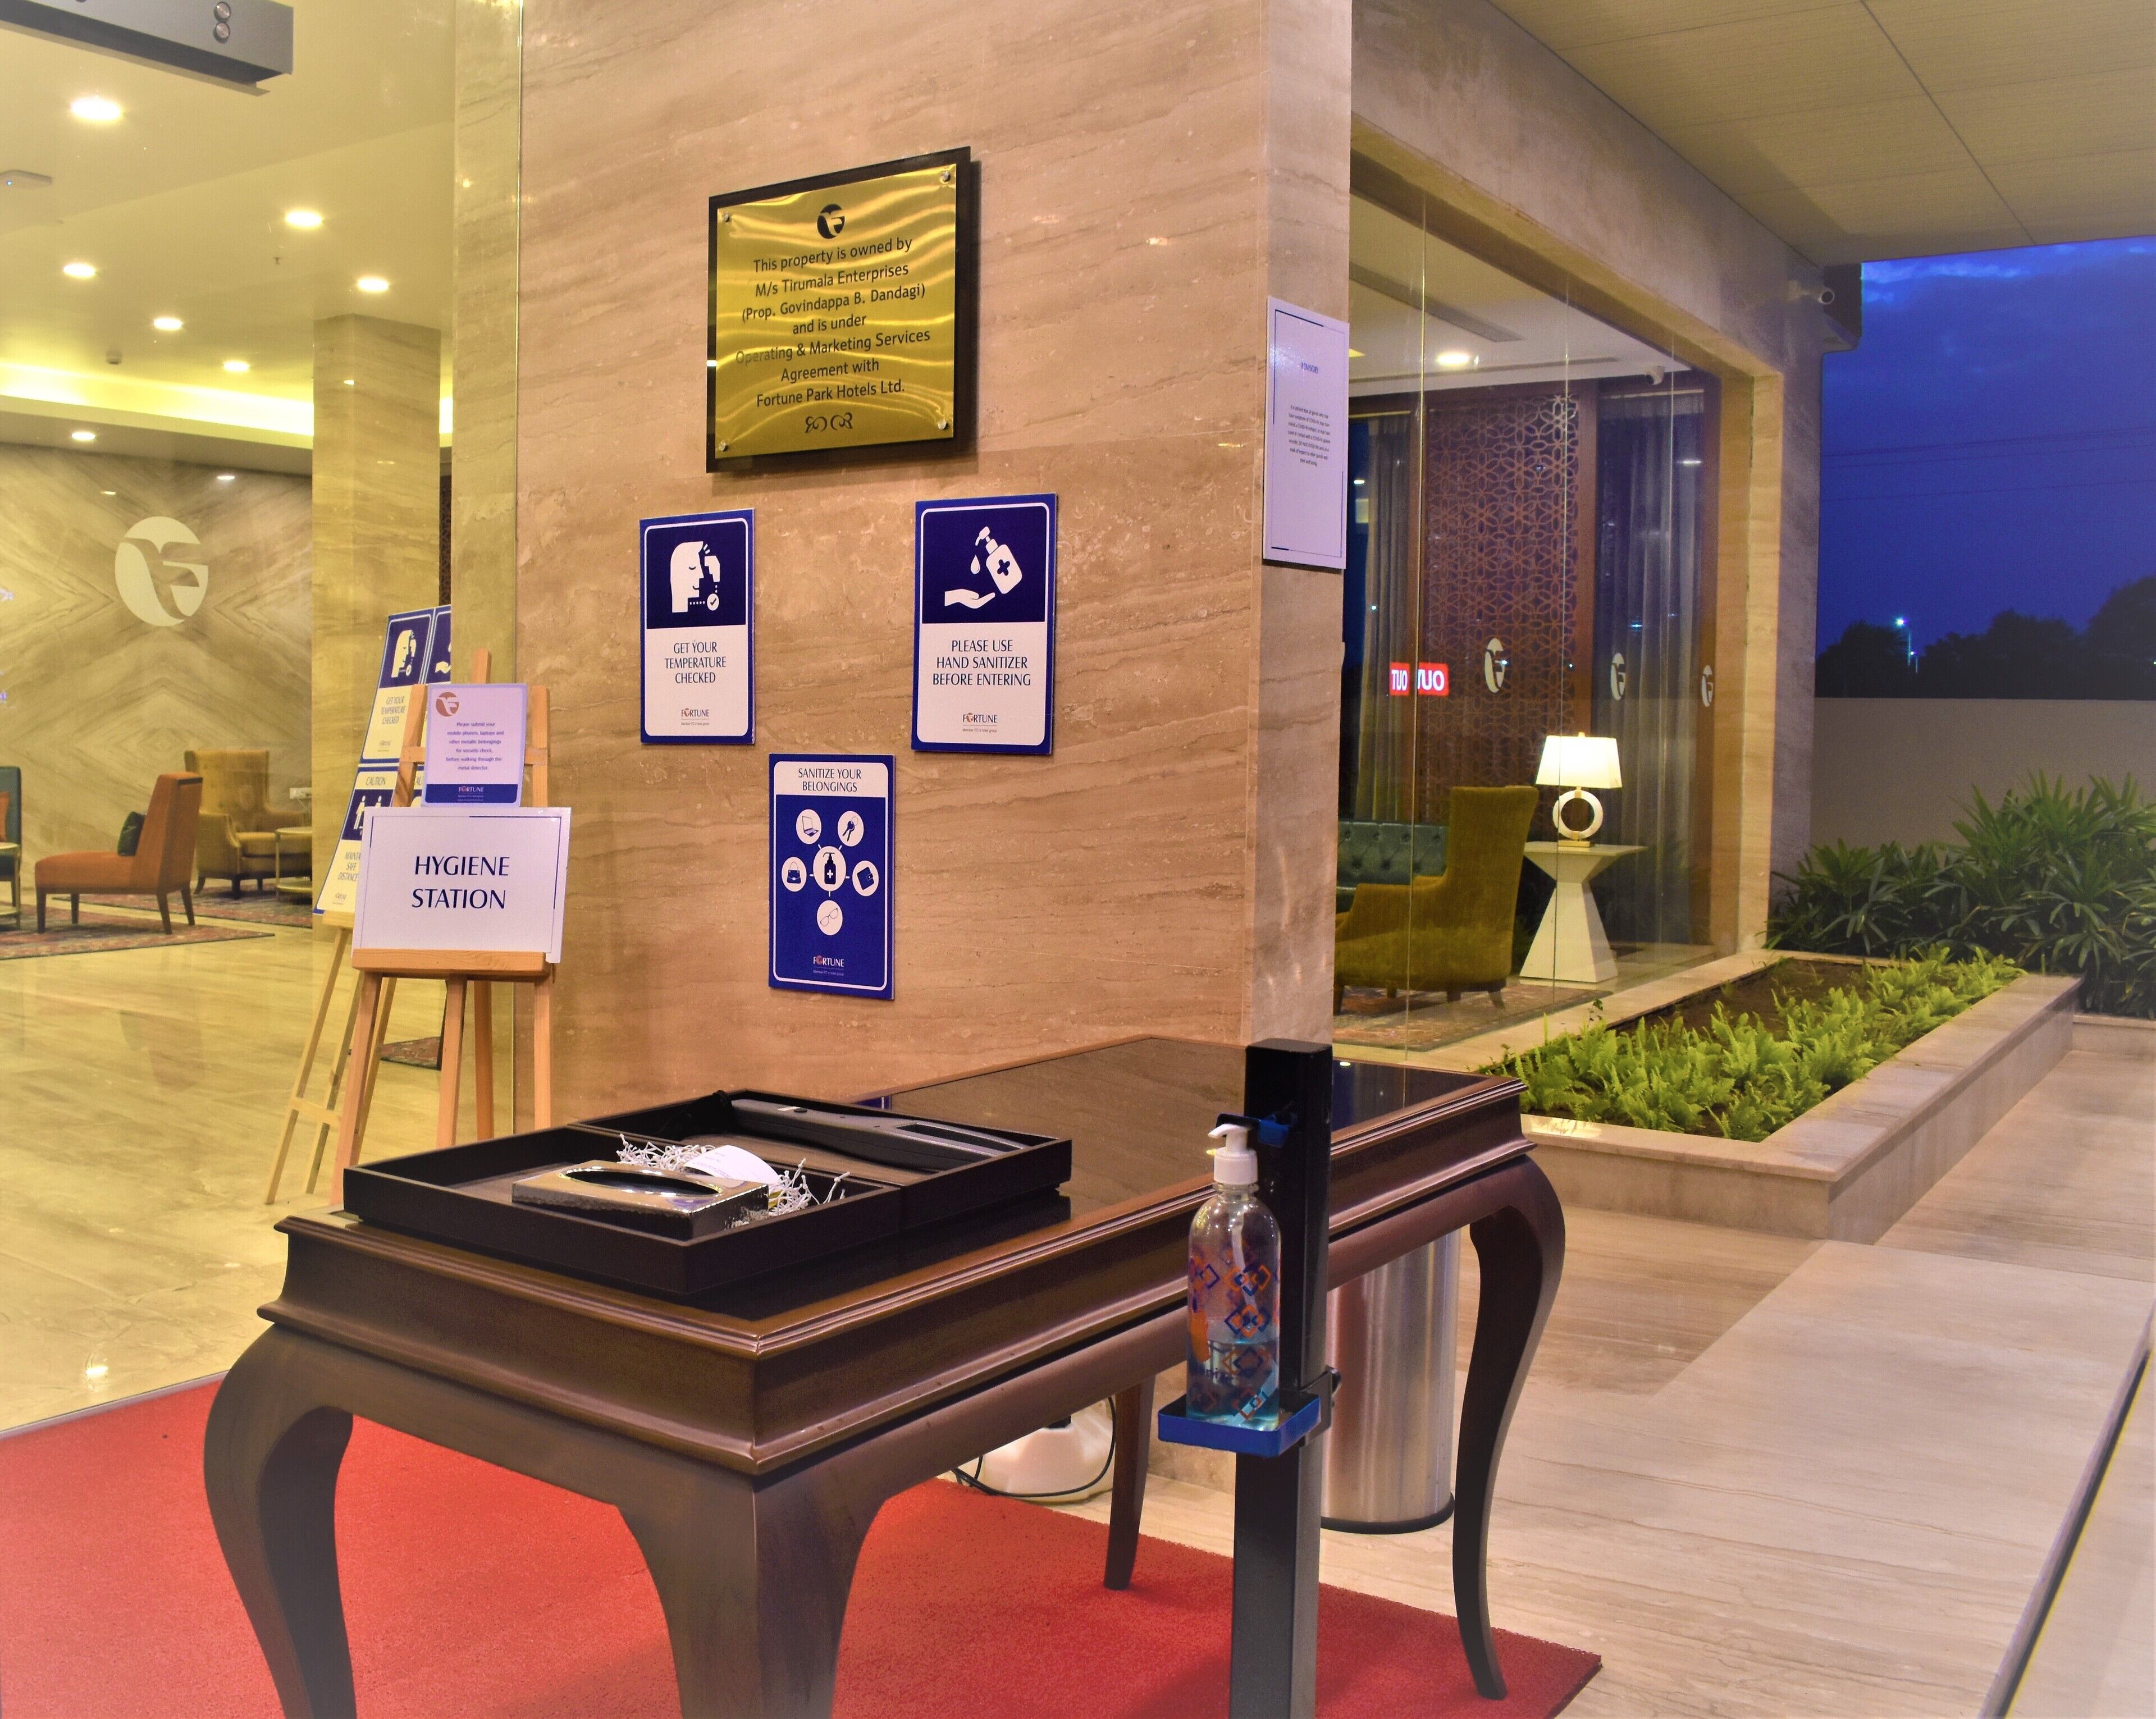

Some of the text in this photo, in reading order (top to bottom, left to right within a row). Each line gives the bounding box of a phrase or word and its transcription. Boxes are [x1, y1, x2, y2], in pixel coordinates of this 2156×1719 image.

[754, 236, 912, 273] This property is owned by
[756, 264, 908, 297] M/s Tirumala Enterprises
[742, 283, 925, 323] (Prop. Govindappa B. Dandagi)
[793, 314, 866, 335] and is under
[736, 330, 930, 366] Operating & Marketing Services
[781, 359, 879, 383] Agreement with
[757, 380, 905, 407] Fortune Park Hotels Ltd.
[674, 642, 717, 653] GET YOUR
[952, 640, 1012, 652] PLEASE USE
[665, 656, 726, 669] TEMPERATURE
[937, 657, 1027, 668] HAND SANITIZER
[675, 673, 716, 683] CHECKED
[933, 674, 1030, 685] BEFORE ENTERING
[798, 768, 861, 779] SANITIZE YOUR
[802, 781, 857, 792] BELONGINGS
[415, 856, 510, 876] HYGIENE
[412, 889, 506, 909] STATION
